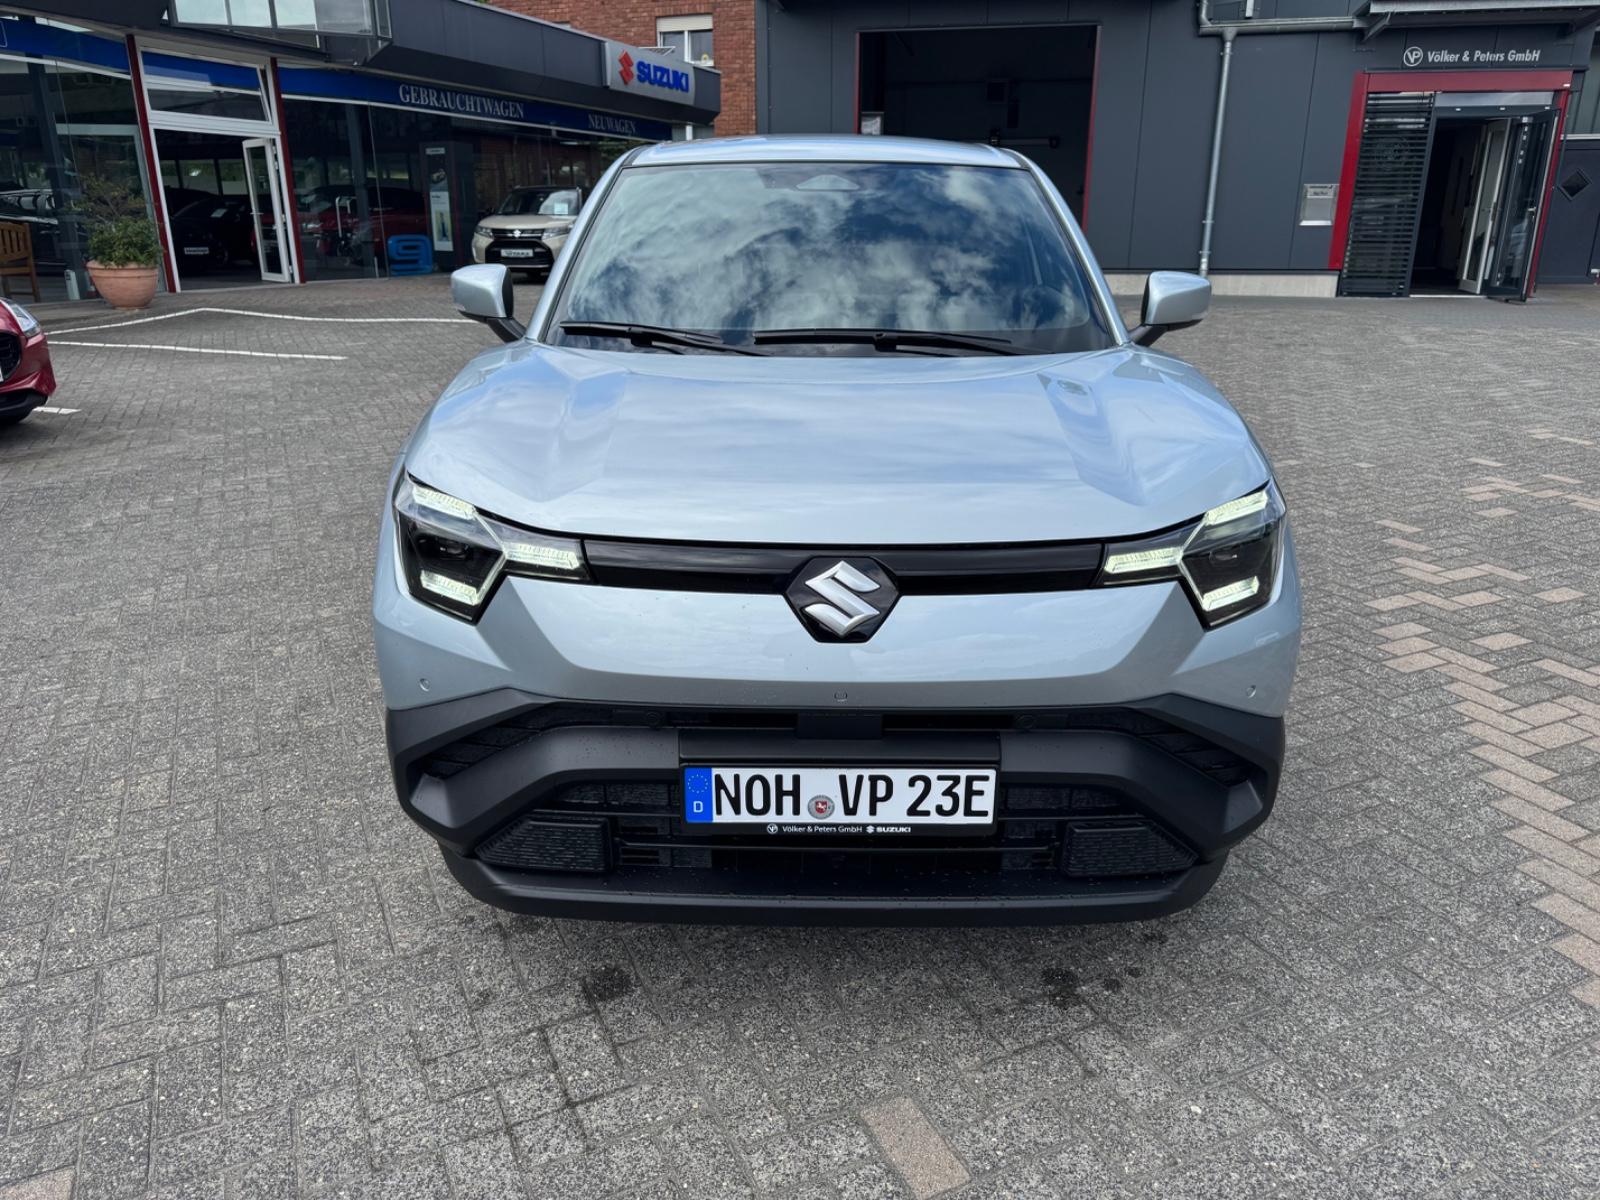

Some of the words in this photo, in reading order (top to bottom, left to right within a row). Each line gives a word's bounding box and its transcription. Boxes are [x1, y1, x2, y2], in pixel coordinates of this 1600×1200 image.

[1427, 49, 1460, 63] Völker
[1462, 50, 1470, 62] &
[1473, 50, 1505, 63] Peters
[1508, 49, 1541, 62] GmbH
[637, 61, 689, 93] SUZUKI
[399, 84, 524, 119] GEBRAUCHTWAGEN
[588, 114, 636, 134] NEUWAGEN
[714, 773, 801, 817] NOH
[838, 774, 894, 817] VP
[906, 775, 990, 818] 23E
[693, 801, 704, 813] D
[782, 825, 806, 833] Völker
[807, 825, 813, 833] &
[814, 825, 837, 833] Peters
[838, 825, 862, 833] GmbH
